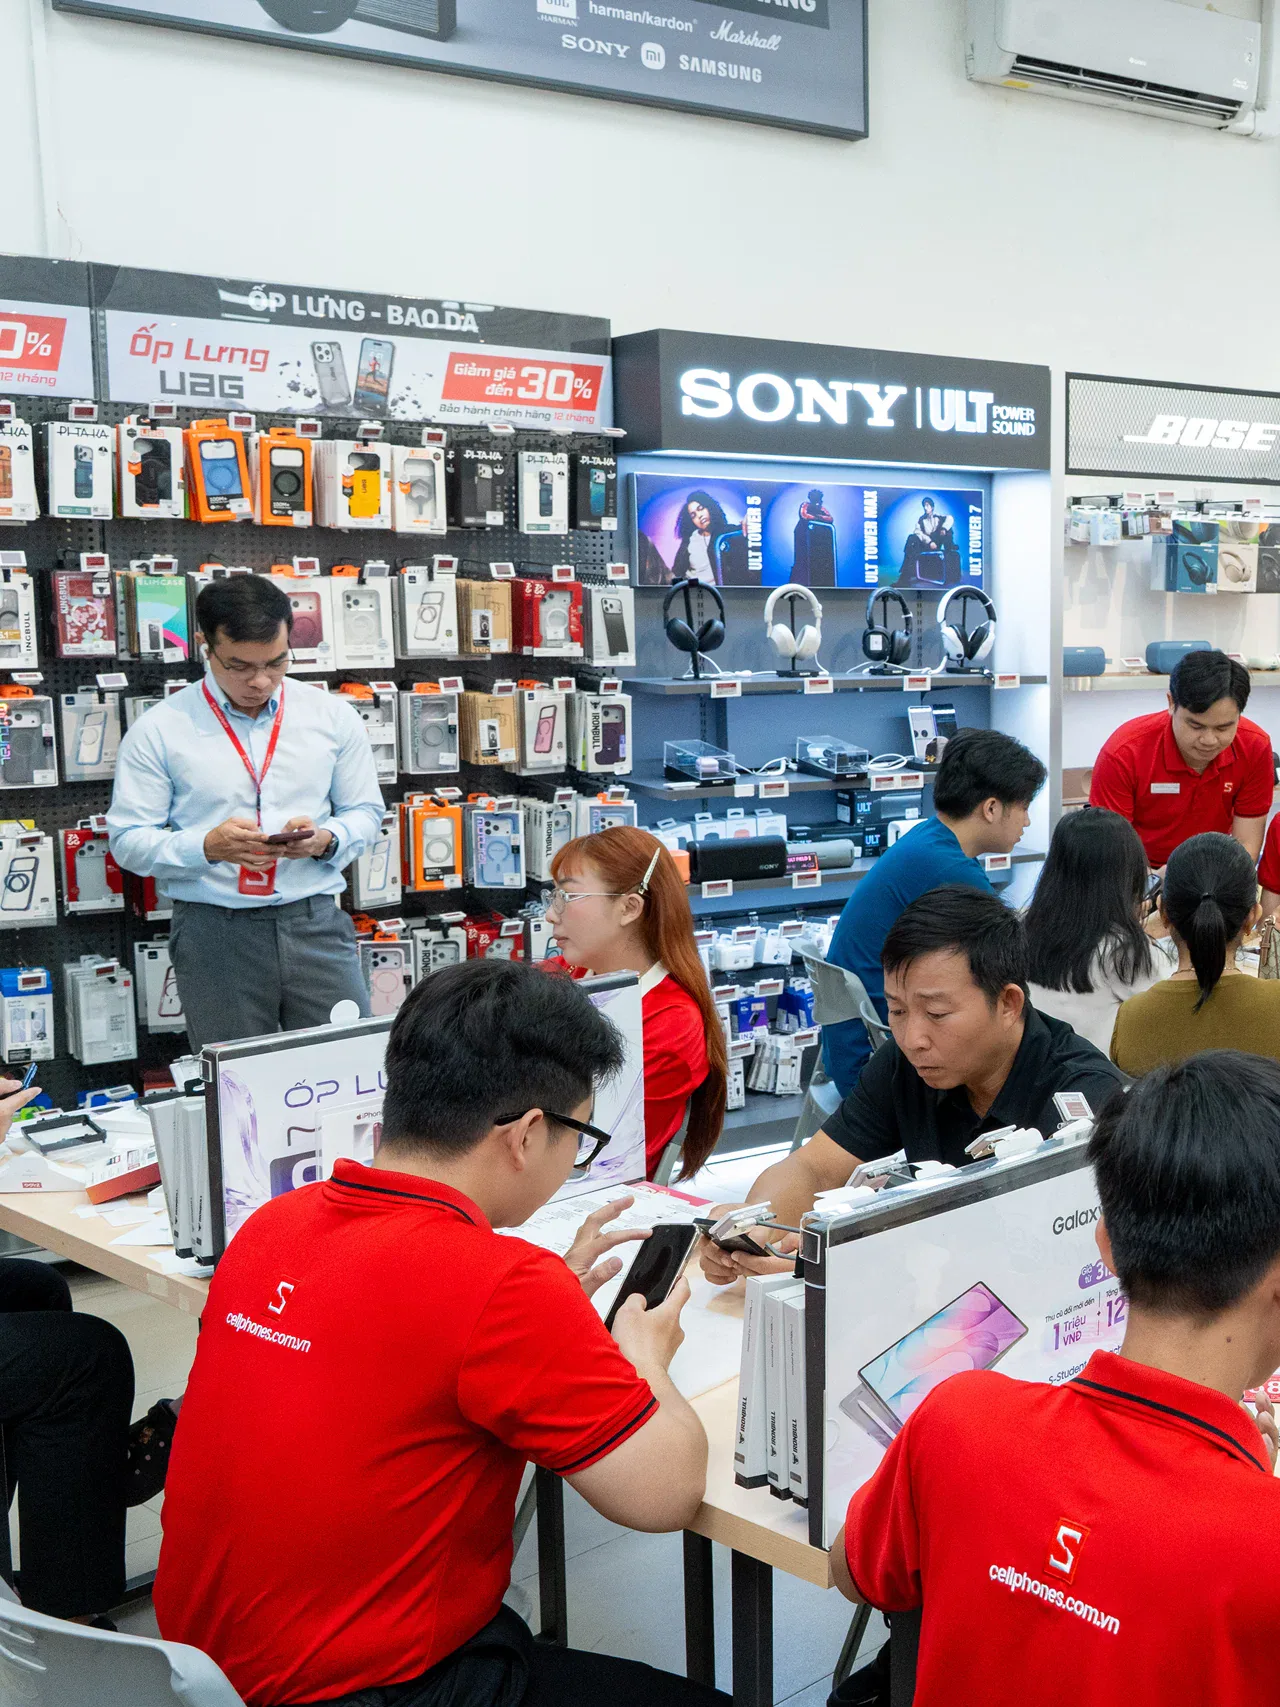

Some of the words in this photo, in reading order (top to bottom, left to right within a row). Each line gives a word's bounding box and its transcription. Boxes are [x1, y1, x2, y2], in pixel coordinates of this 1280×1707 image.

[589, 0, 694, 33] harman/kardon
[710, 19, 782, 51] Marshall
[561, 34, 630, 59] SONY
[679, 54, 762, 84] SAMSUNG
[247, 284, 286, 313] ỐP
[292, 294, 365, 321] LƯNG
[387, 305, 439, 329] BAO
[445, 310, 479, 334] DA
[129, 324, 174, 364] Ốp
[184, 338, 270, 372] Lưng
[17, 373, 57, 387] tháng
[453, 362, 491, 378] Giảm
[493, 364, 516, 381] giá
[485, 384, 513, 398] đến
[517, 366, 593, 402] 30%
[439, 403, 461, 414] Bảo
[463, 405, 491, 416] hành
[493, 405, 524, 420] chính
[525, 409, 552, 422] hãng
[554, 411, 564, 421] 12
[565, 412, 595, 424] tháng
[679, 367, 908, 428] SONY
[929, 386, 994, 434] ULT
[992, 404, 1036, 421] POWER
[57, 426, 109, 439] PITAKA
[992, 421, 1036, 437] SOUND
[863, 490, 878, 519] MAX
[968, 505, 982, 514] 7
[747, 508, 763, 545] TOWER
[864, 520, 879, 558] TOWER
[969, 515, 983, 551] TOWER
[748, 546, 763, 571] ULT
[864, 559, 879, 584] ULT
[969, 552, 983, 576] ULT
[58, 575, 68, 614] KINGBULL
[592, 712, 600, 750] IRONBULL
[857, 802, 872, 813] ULT
[546, 820, 554, 859] IRONBULL
[865, 834, 881, 845] ULT
[759, 863, 780, 871] SONY
[284, 1079, 340, 1109] ỐP
[361, 1109, 383, 1119] iPhon
[1045, 1314, 1056, 1323] Thu
[1073, 1301, 1084, 1312] mới
[226, 1312, 312, 1353] cellphones.com.vn
[1053, 1322, 1060, 1351] 1
[1063, 1315, 1086, 1332] Triệu
[1063, 1330, 1082, 1346] VNĐ
[989, 1564, 1121, 1635] cellphones.com.vn
